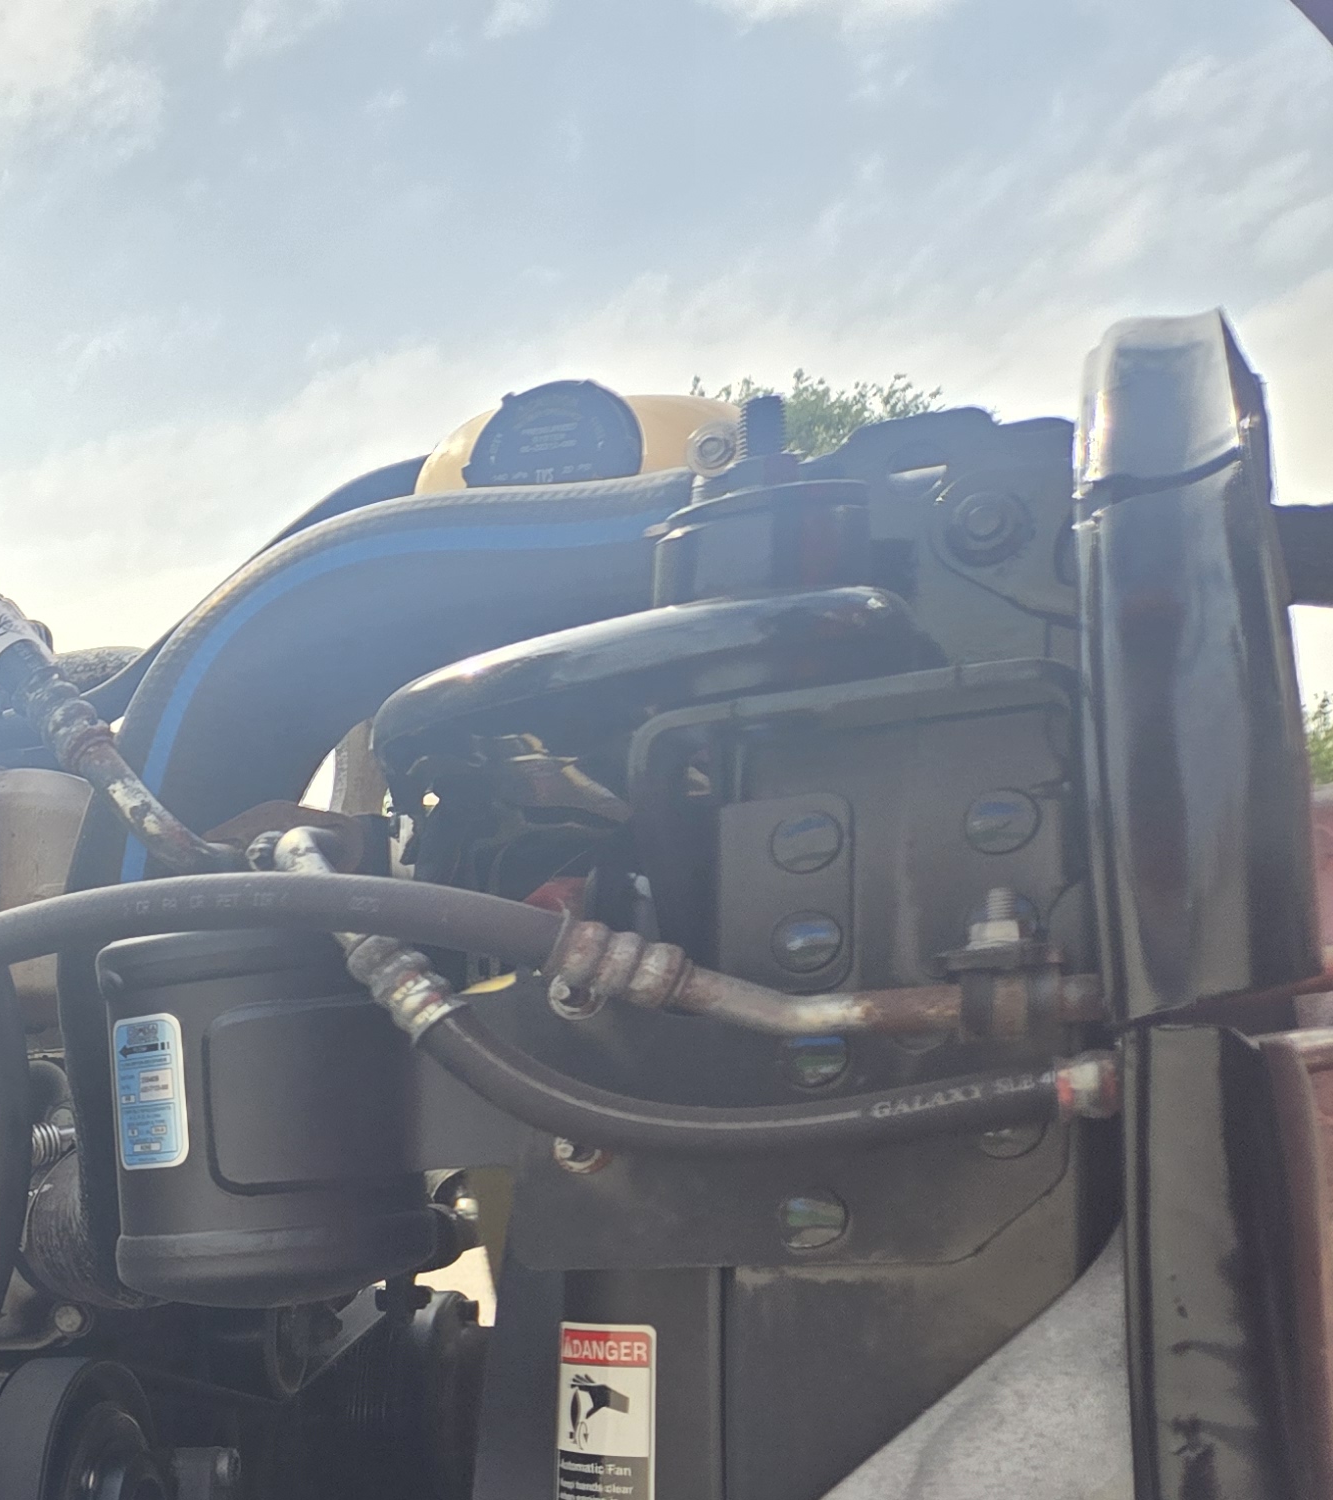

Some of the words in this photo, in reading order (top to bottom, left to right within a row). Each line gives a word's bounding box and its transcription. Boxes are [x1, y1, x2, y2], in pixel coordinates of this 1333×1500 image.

[871, 1084, 982, 1119] GALAXY
[573, 1339, 648, 1362] DANGER
[605, 1464, 632, 1477] Fan
[604, 1484, 634, 1495] clear
